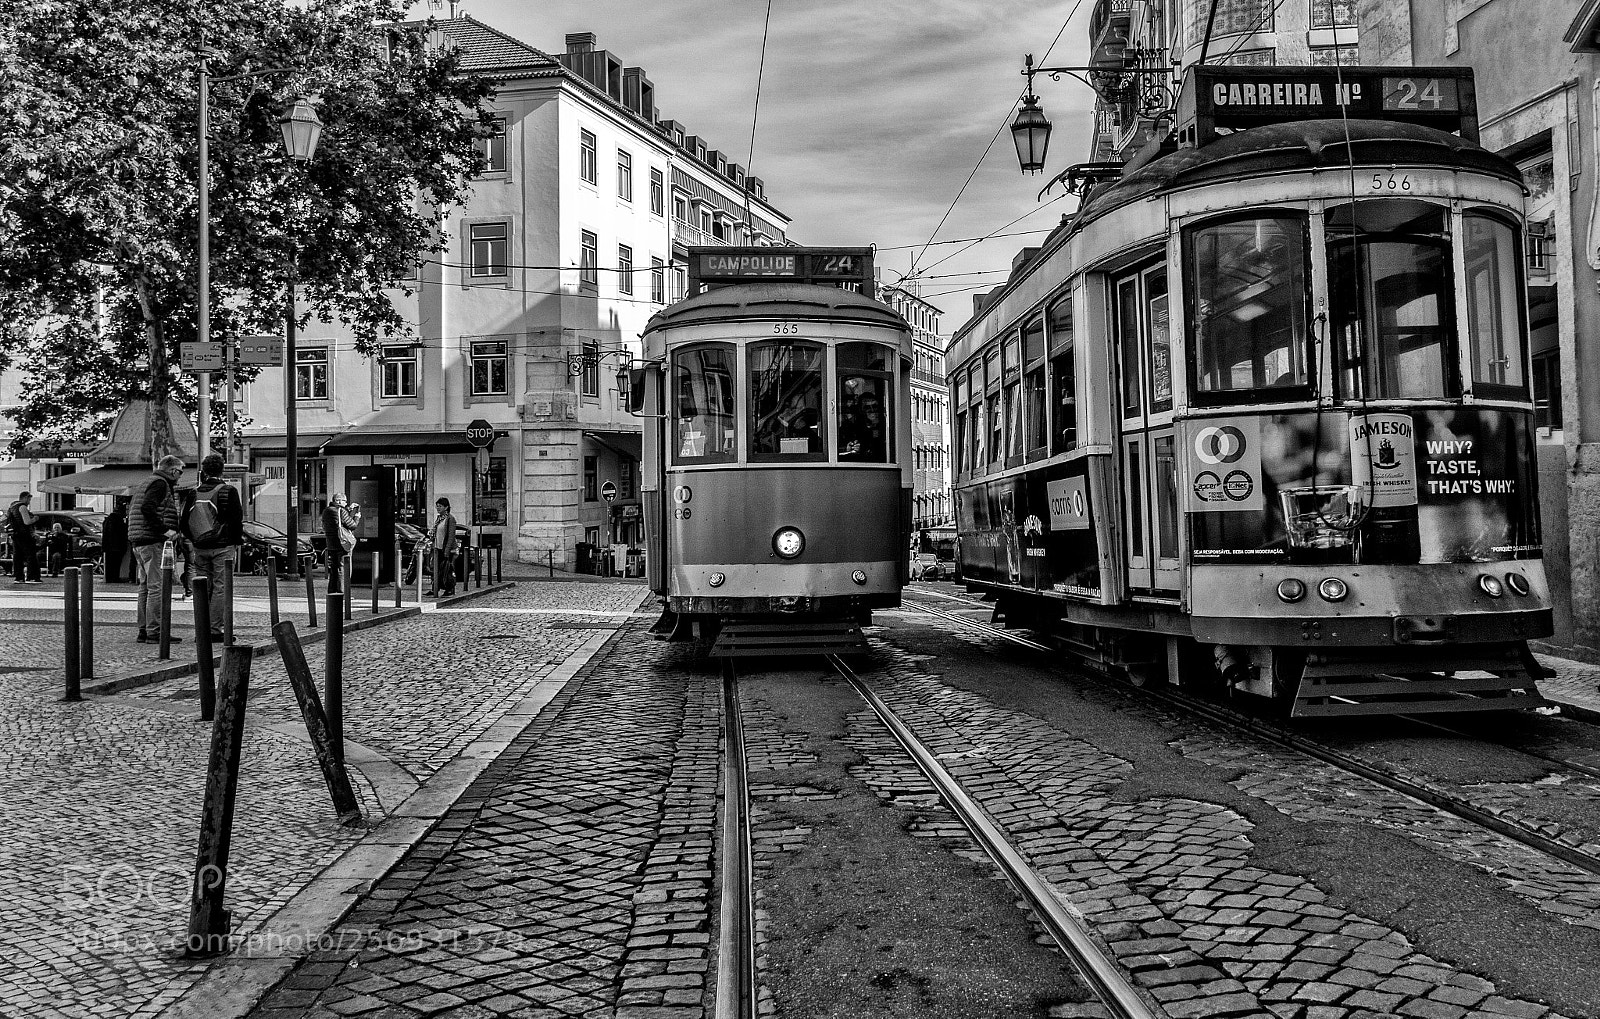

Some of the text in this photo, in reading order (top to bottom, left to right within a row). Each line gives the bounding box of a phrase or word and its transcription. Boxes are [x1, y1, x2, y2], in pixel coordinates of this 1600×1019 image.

[1213, 83, 1362, 105] CARREIRA Nº
[1397, 79, 1444, 109] 24
[1371, 174, 1411, 191] 566
[708, 256, 794, 270] CAMPOLIDE
[823, 255, 854, 272] 24
[773, 324, 798, 334] 565
[467, 428, 493, 439] STOP
[1354, 421, 1412, 441] JAMESON
[1426, 440, 1473, 454] WHY?
[1426, 460, 1481, 477] TASTE,
[1427, 479, 1482, 494] THAT'S
